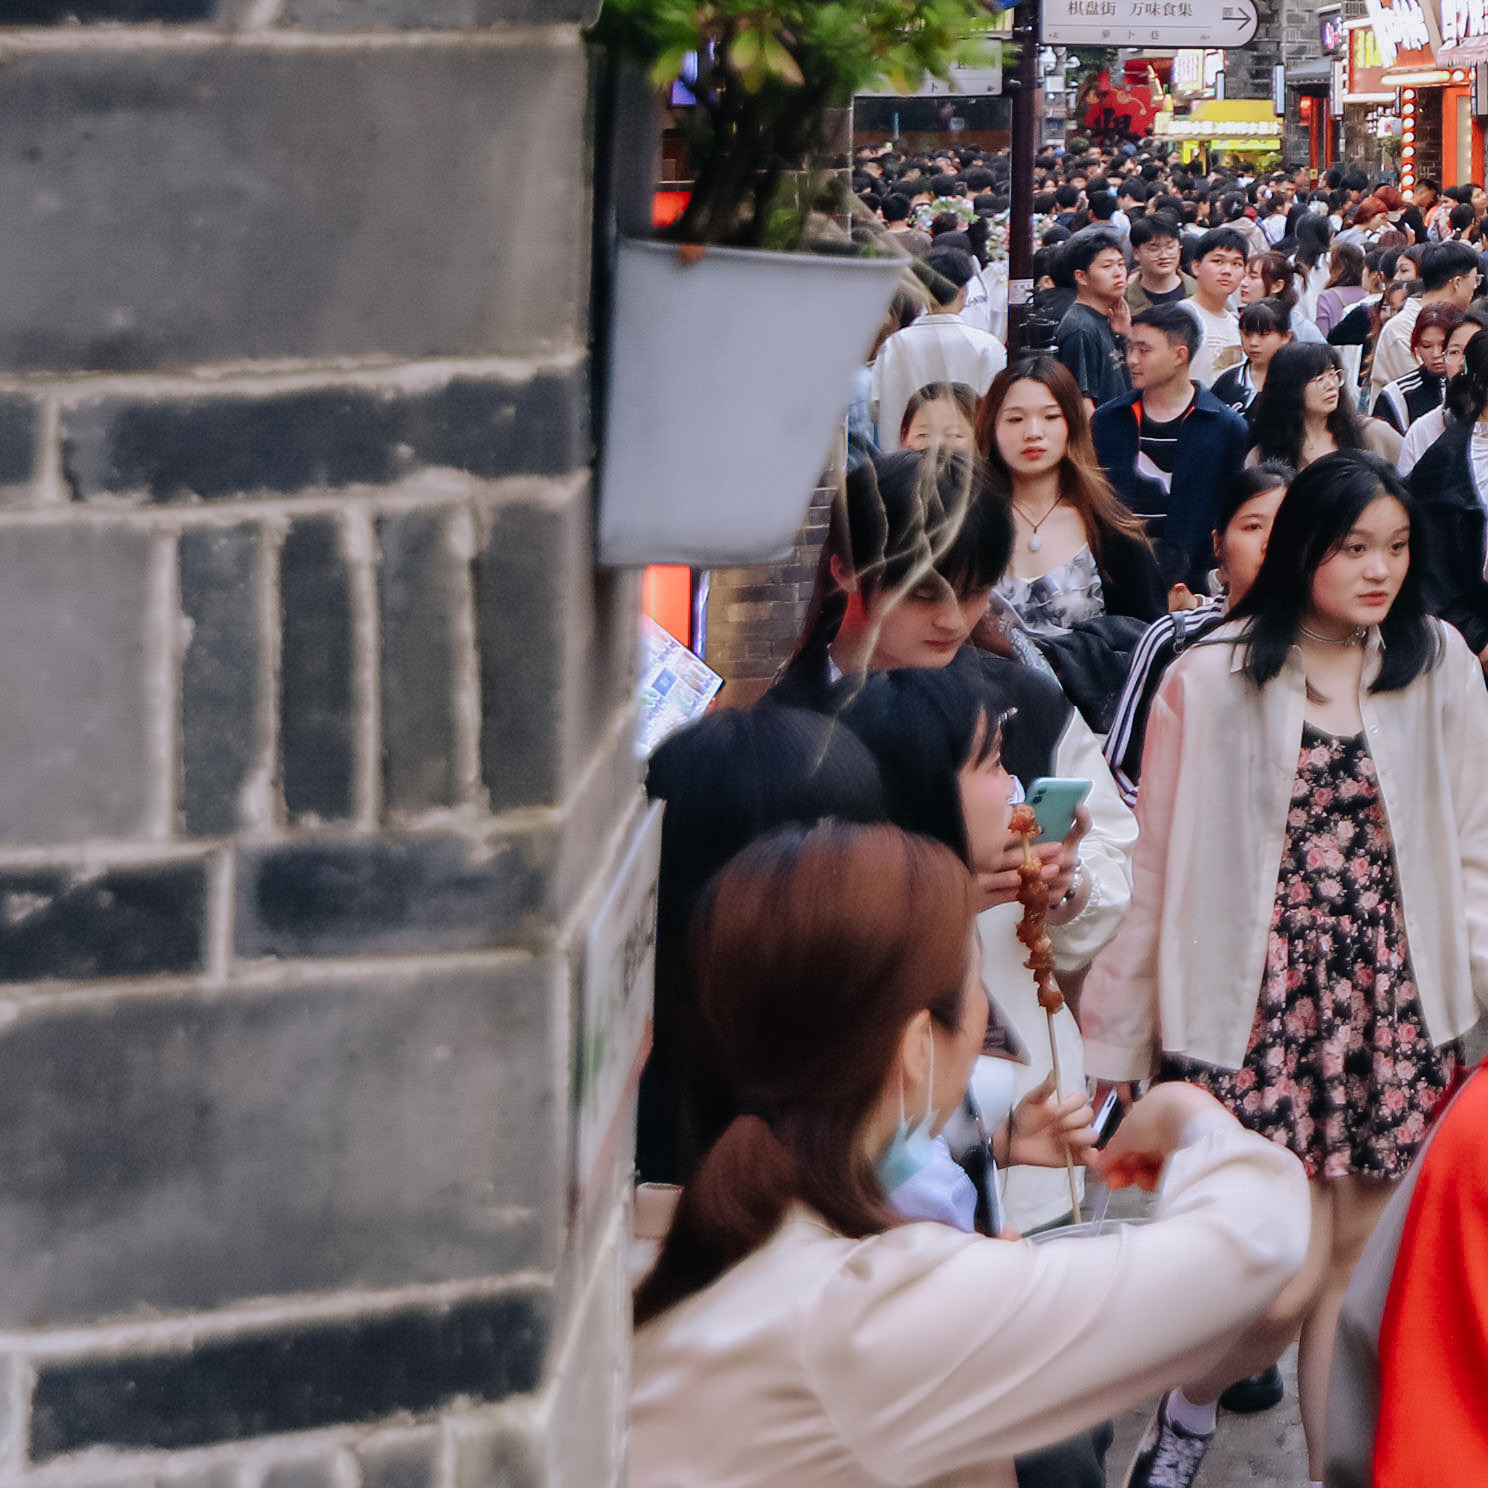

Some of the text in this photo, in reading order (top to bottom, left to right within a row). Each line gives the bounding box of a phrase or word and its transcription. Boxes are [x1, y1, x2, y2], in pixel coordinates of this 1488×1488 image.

[1068, 0, 1193, 17] 棋盘街 万味食集
